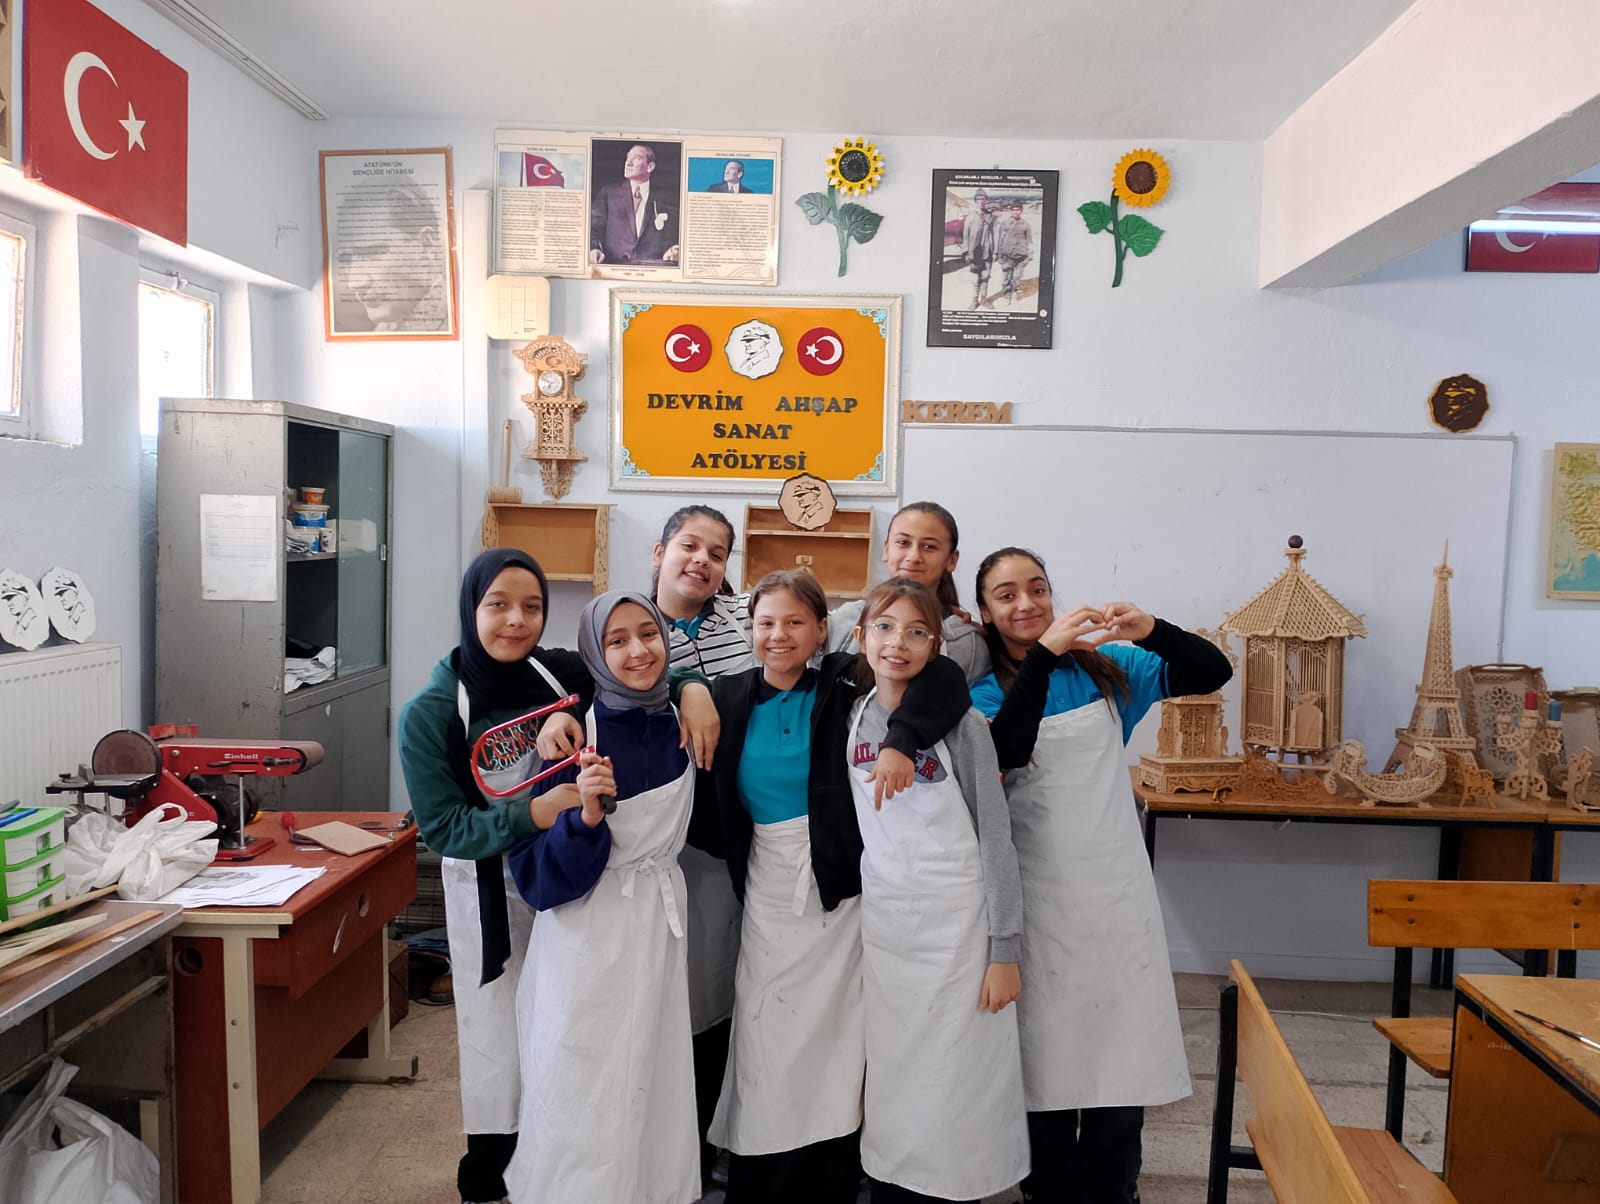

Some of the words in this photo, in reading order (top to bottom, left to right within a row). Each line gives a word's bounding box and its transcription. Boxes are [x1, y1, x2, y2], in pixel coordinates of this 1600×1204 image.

[647, 391, 744, 411] DEVRİM
[775, 396, 858, 417] AHŞAP
[902, 400, 1012, 424] KEREM
[713, 423, 793, 440] SANAT
[691, 449, 807, 471] ATÖLYESİ
